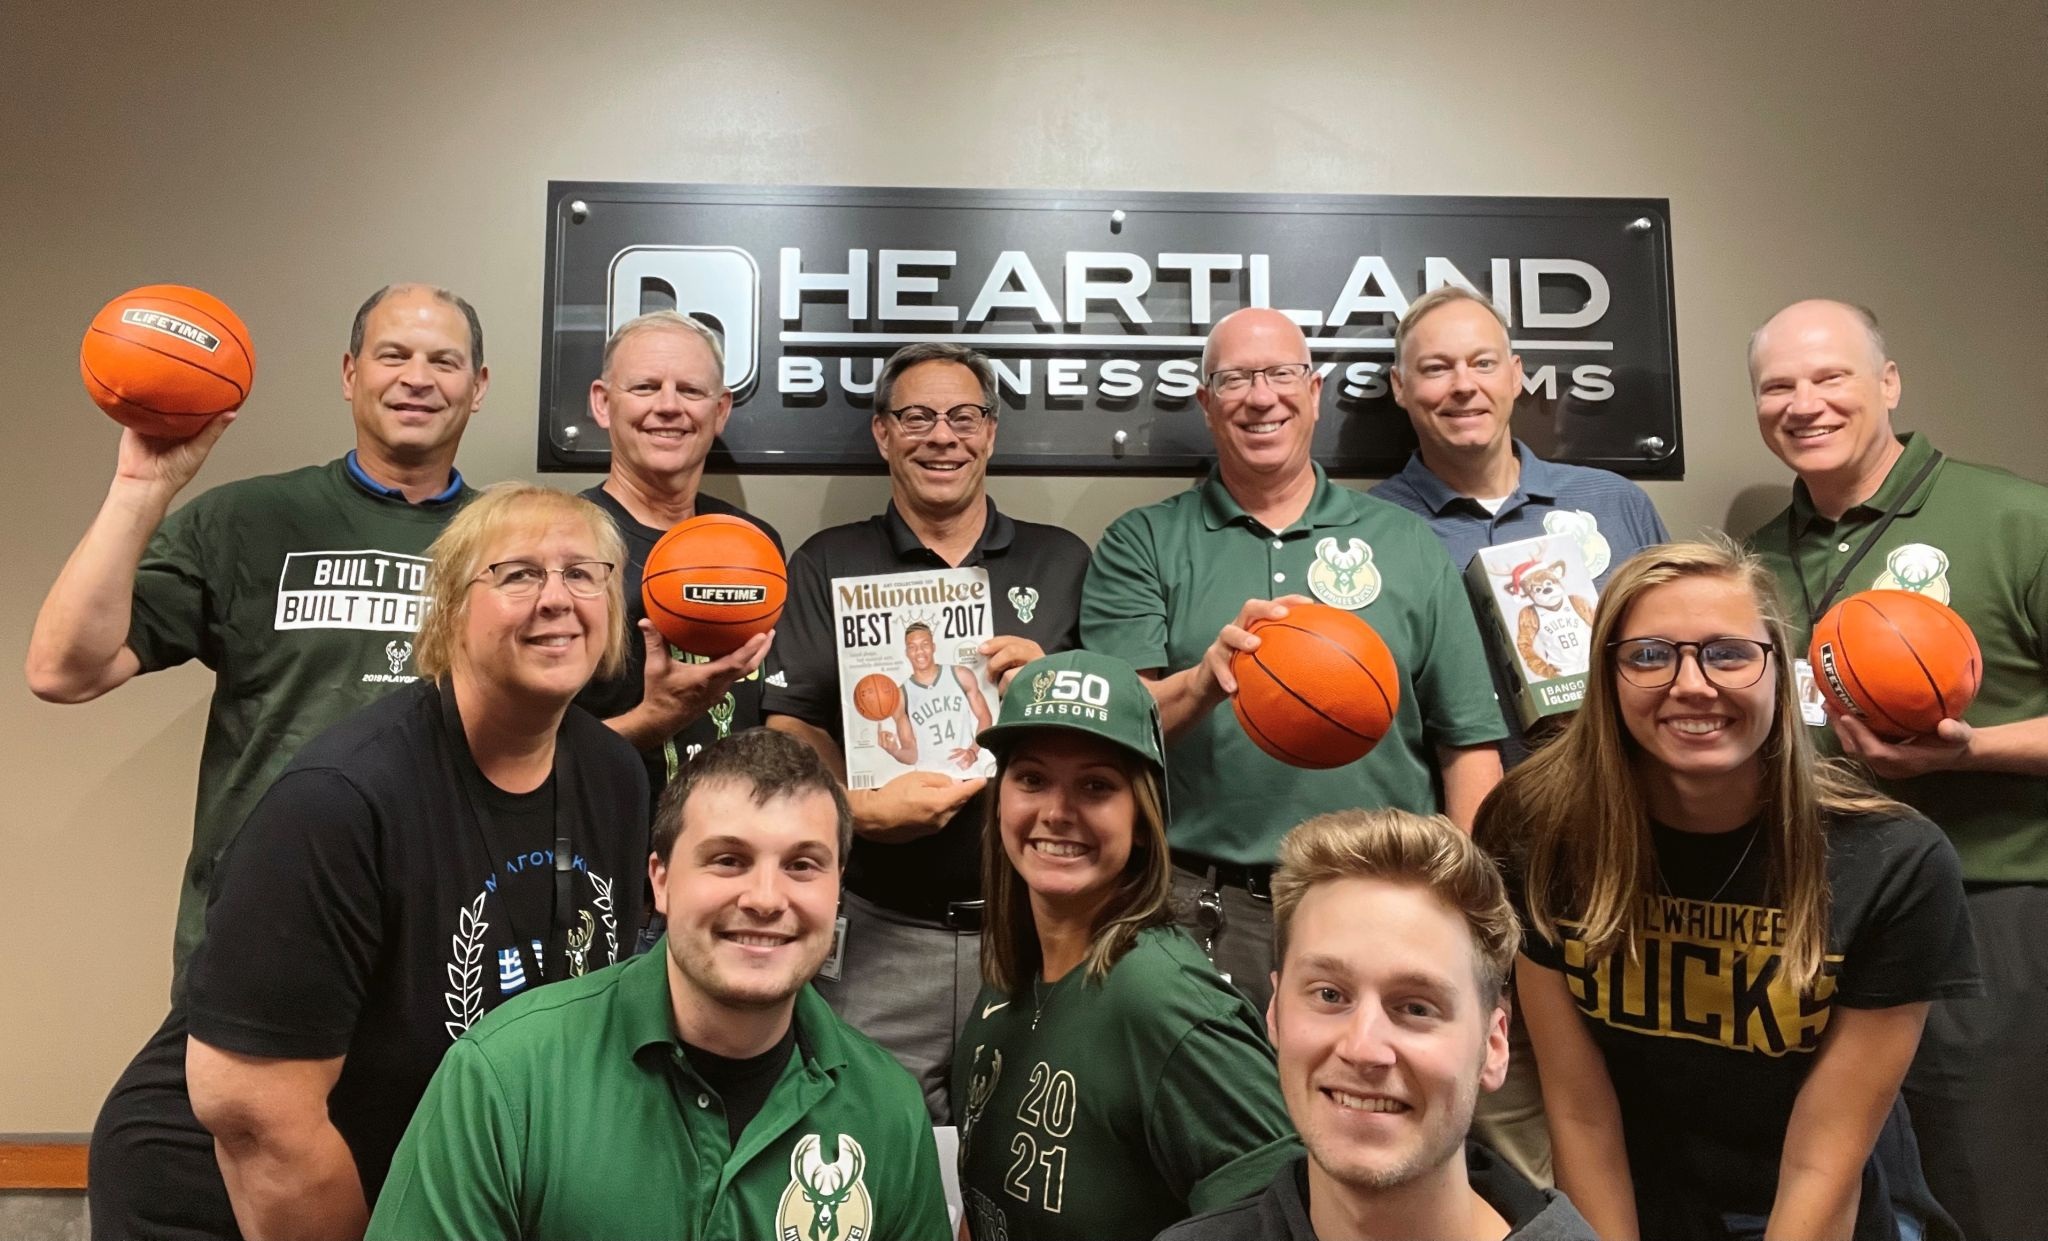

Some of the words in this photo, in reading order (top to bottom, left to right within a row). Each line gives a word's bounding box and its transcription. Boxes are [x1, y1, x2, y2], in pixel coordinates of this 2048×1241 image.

[779, 247, 1611, 328] HEARTLAND
[132, 311, 208, 345] LIFETIME
[778, 357, 1199, 397] BUNESS
[314, 558, 389, 587] BUILT
[396, 562, 426, 591] TO
[282, 595, 359, 623] BUILT
[367, 597, 398, 625] TO
[692, 587, 758, 601] LIFETIME
[838, 577, 985, 612] Milwaukee
[842, 612, 892, 648] BEST
[942, 603, 985, 639] 2017
[1543, 617, 1580, 634] BUCKS
[1558, 632, 1579, 650] 68
[1051, 670, 1110, 706] 50
[1546, 680, 1585, 696] BANGO
[911, 696, 962, 726] BUCKS
[1024, 704, 1108, 722] SEASONS
[929, 719, 956, 746] 34
[1643, 896, 1787, 948] LWAUKEE
[1016, 1061, 1077, 1138] 20
[1004, 1131, 1067, 1214] 21
